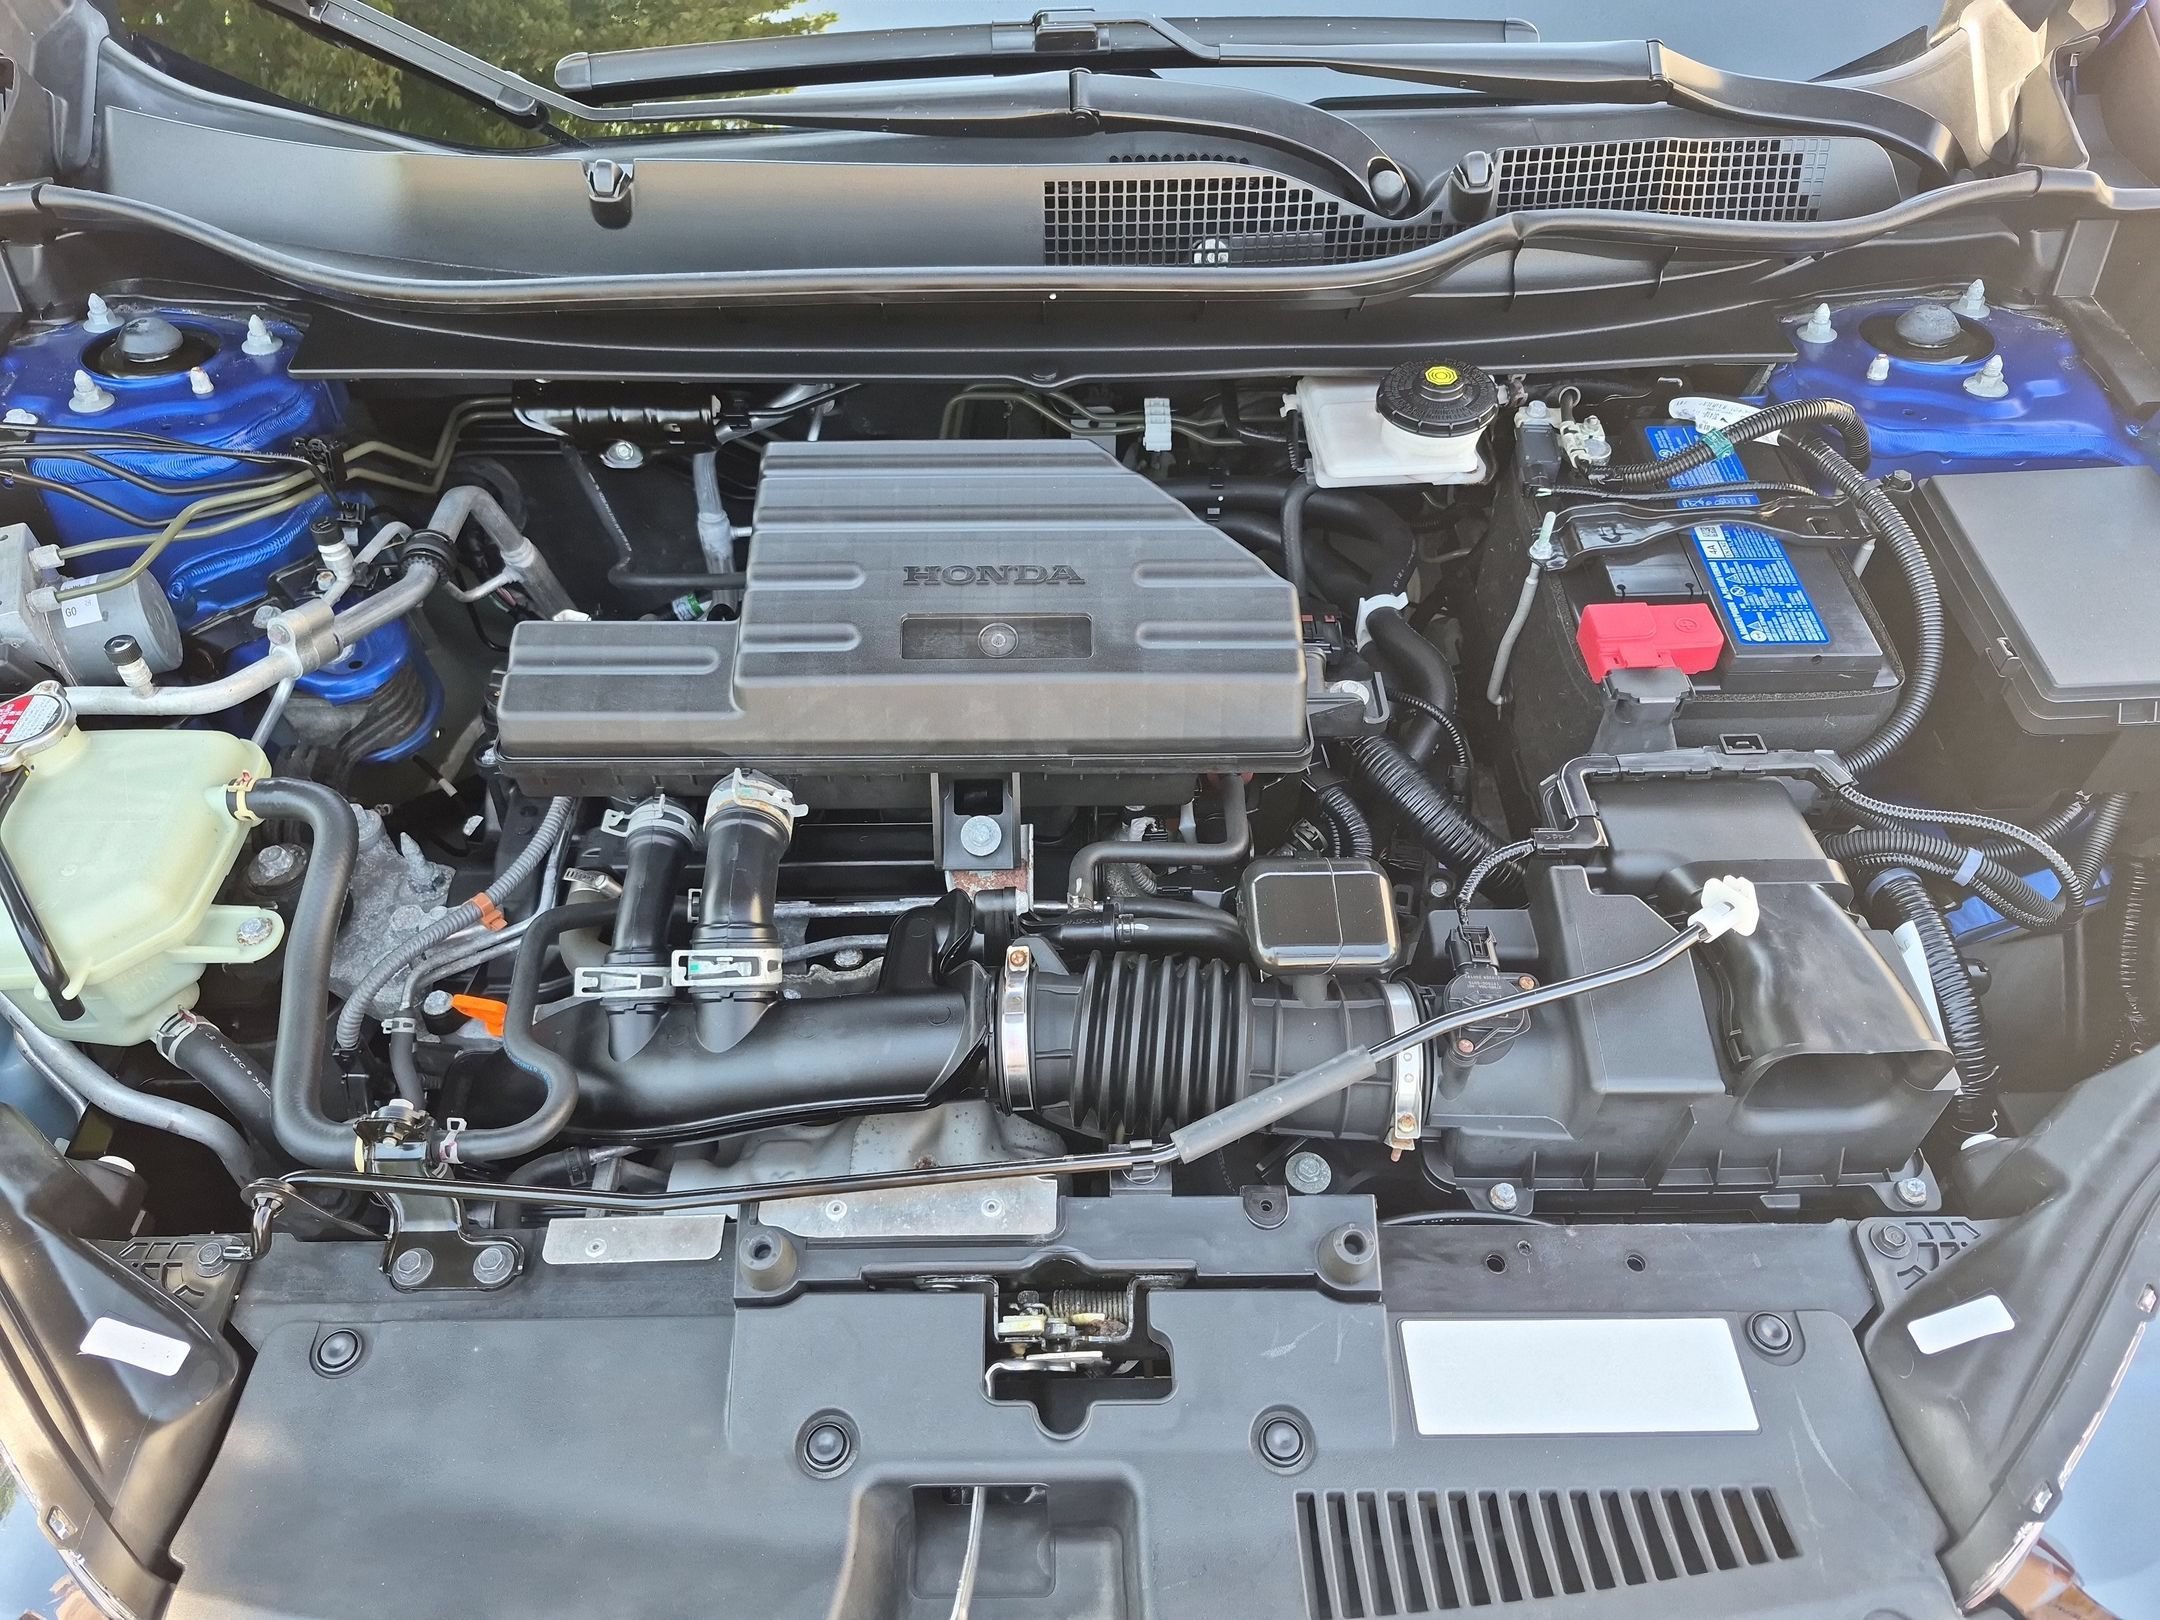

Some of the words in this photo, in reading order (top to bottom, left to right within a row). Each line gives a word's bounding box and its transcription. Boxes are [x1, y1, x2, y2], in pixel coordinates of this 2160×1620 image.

[1706, 544, 1718, 555] 4A
[903, 565, 1086, 585] HONDA
[219, 1043, 246, 1070] Y-TEC
